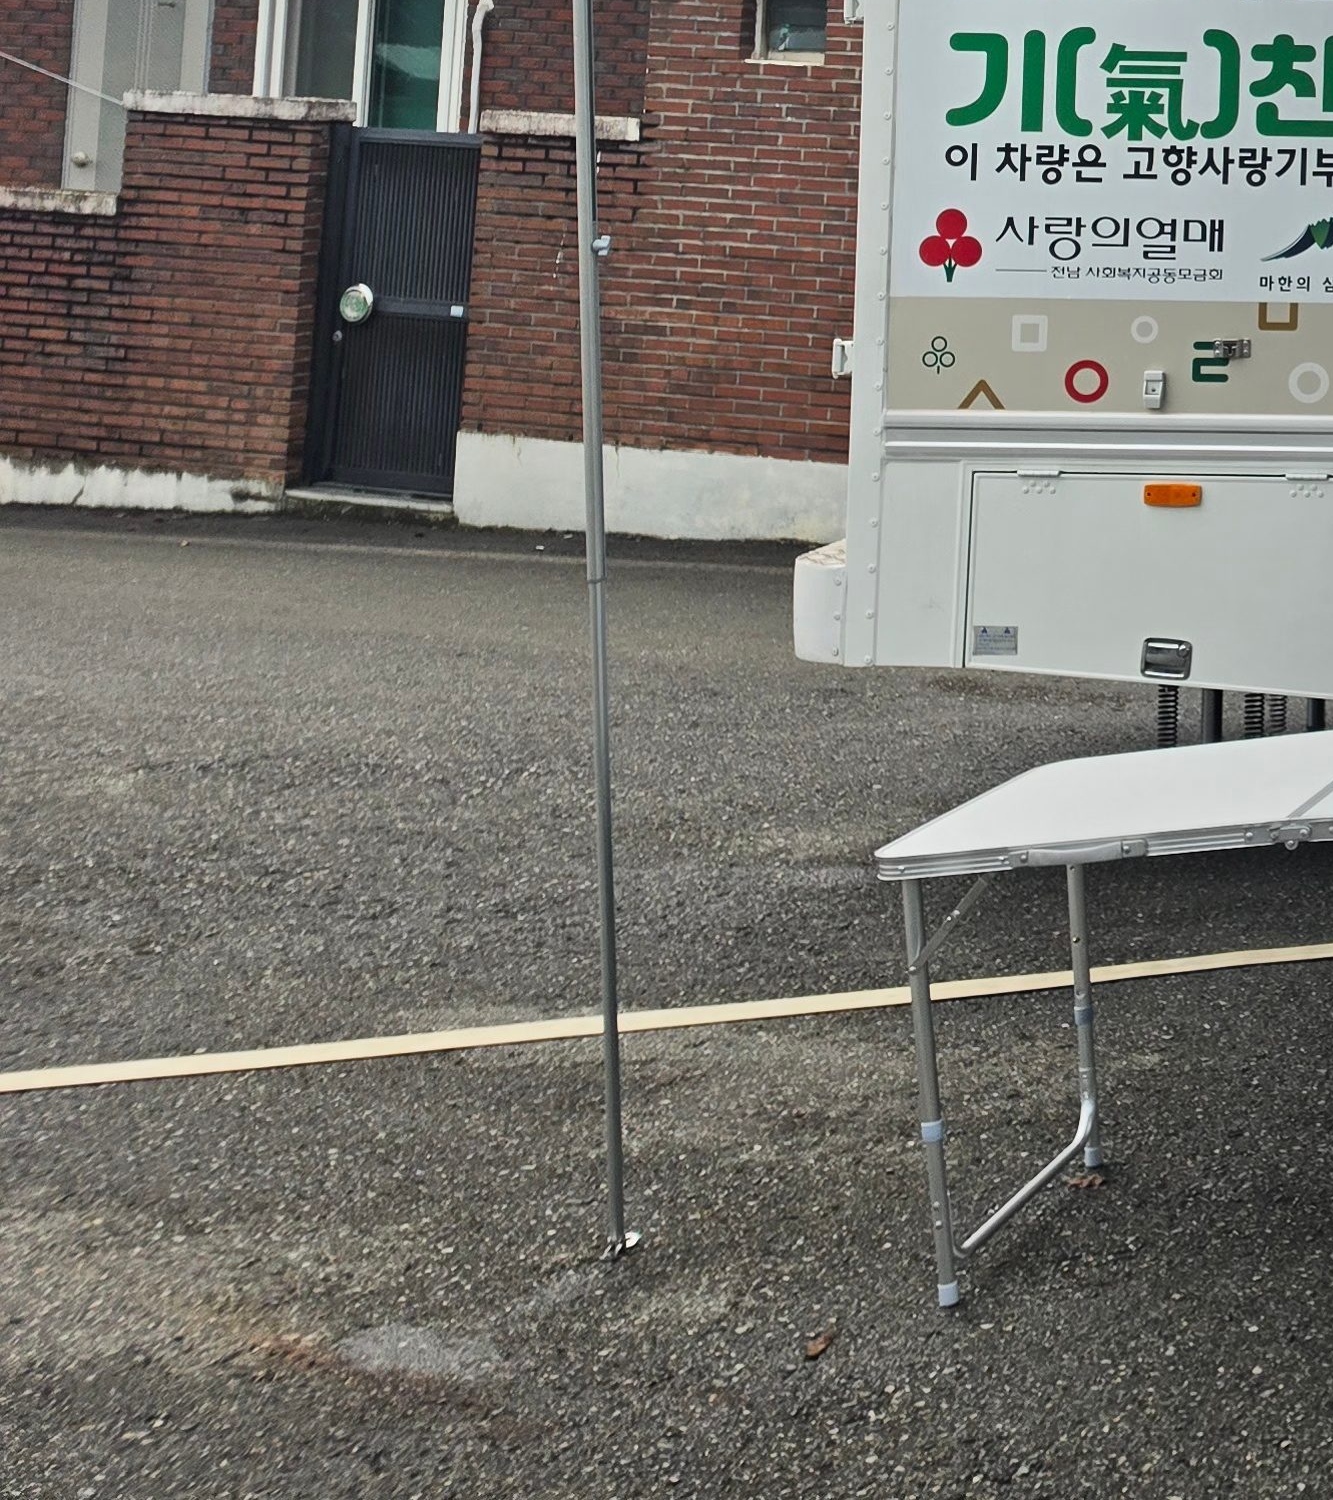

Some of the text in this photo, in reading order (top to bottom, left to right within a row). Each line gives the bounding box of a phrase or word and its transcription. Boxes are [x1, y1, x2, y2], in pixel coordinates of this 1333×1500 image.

[944, 143, 979, 182] 이
[995, 143, 1107, 186] 차량은
[995, 216, 1225, 261] 사랑의열매
[1051, 266, 1224, 285] 전남 사회복지공동모금회
[1259, 275, 1312, 292] 마한의
